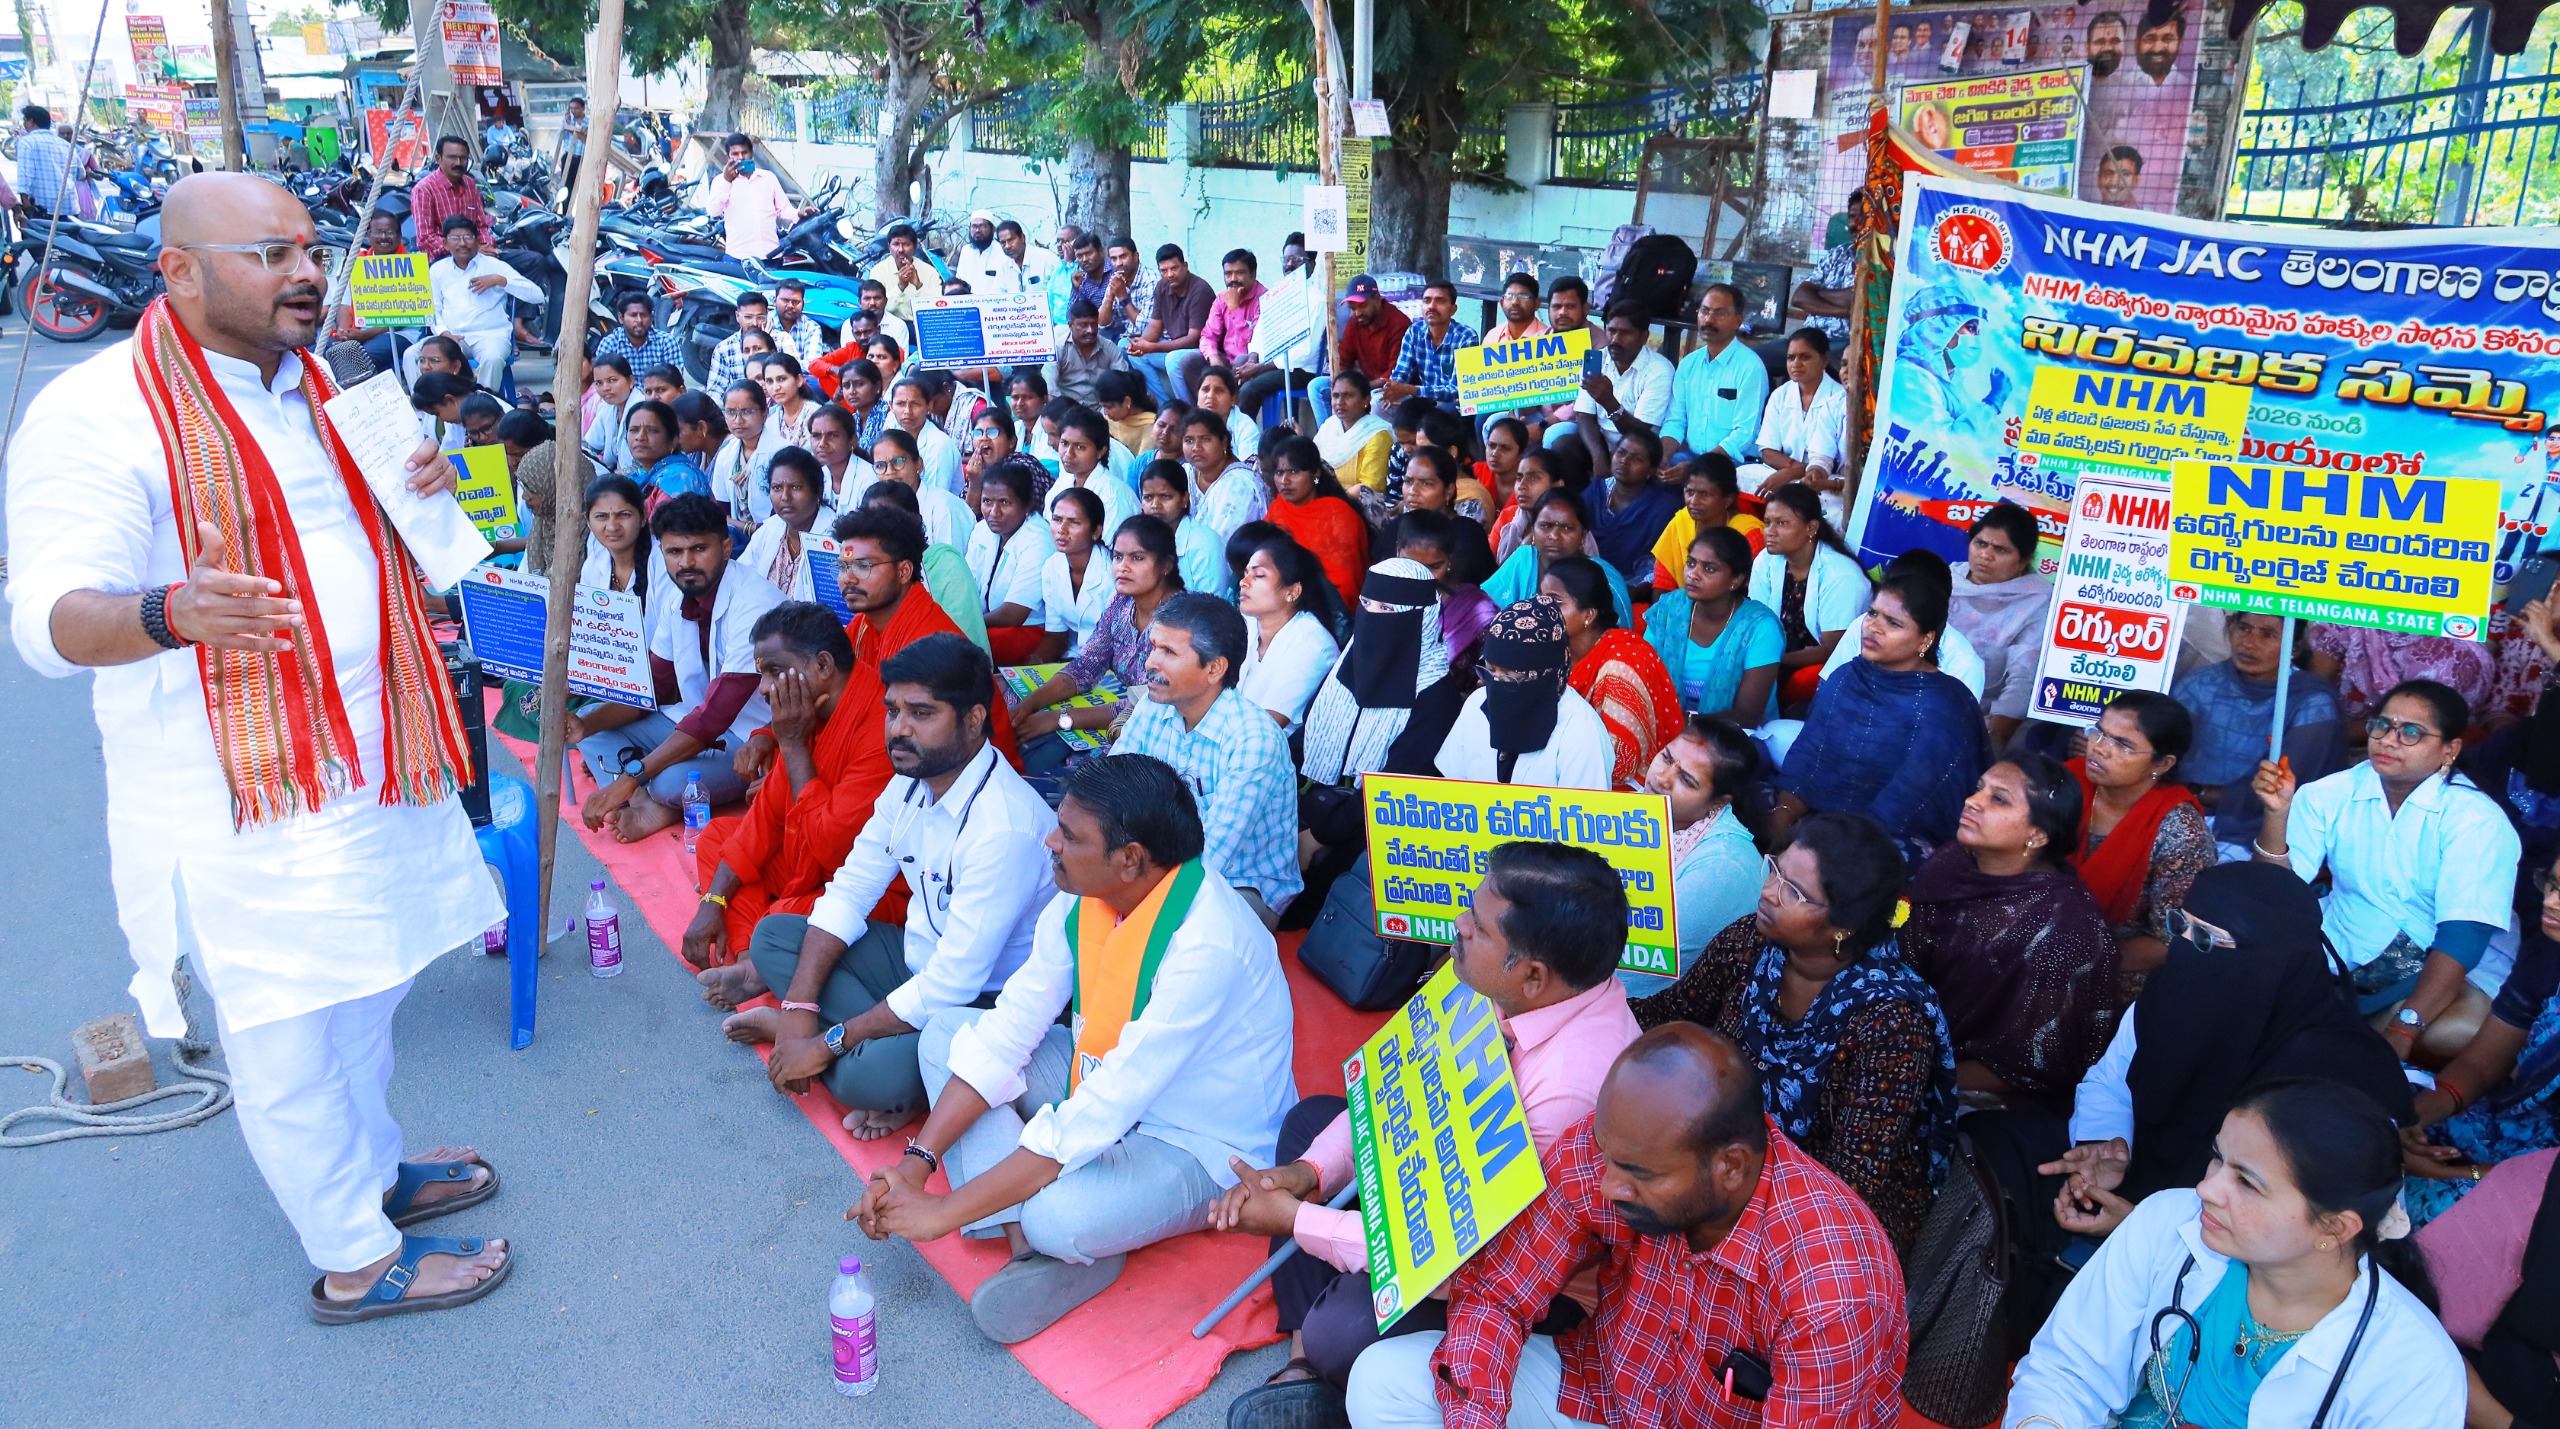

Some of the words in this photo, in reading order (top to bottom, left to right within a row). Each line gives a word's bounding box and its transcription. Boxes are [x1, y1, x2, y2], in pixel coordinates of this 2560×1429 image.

[456, 4, 490, 12] Nalanda
[462, 43, 498, 51] PHYSICS
[1953, 206, 1998, 223] HEALTH
[1992, 223, 2012, 273] MISSION
[363, 257, 415, 280] NHM
[2043, 223, 2150, 271] NHM
[2158, 232, 2268, 282] JAC
[2280, 249, 2483, 300] తెలంగాణ
[411, 316, 425, 324] STATE
[2023, 276, 2081, 302] NHM
[2085, 285, 2170, 319] ఉద్యోగుల
[2174, 304, 2297, 337] న్యాయమైన
[2302, 315, 2393, 347] హక్కుల
[2396, 321, 2477, 351] సాధన
[1483, 336, 1568, 367] NHM
[1506, 365, 1538, 379] ప్రజలకు
[1540, 361, 1554, 371] సేవ
[1463, 389, 1479, 400] మా
[1481, 382, 1527, 397] హక్కులకు
[1529, 376, 1567, 392] గుర్తింపు
[1477, 403, 1496, 412] NHM
[1498, 401, 1510, 409] JAC
[1512, 395, 1555, 407] TELANGANA
[1557, 392, 1578, 402] STATE
[2073, 374, 2207, 418] NHM
[2336, 357, 2546, 433] సమ్మె
[2032, 405, 2054, 424] ఏళ్ల
[2055, 409, 2099, 426] తరబడి
[2100, 415, 2151, 433] ప్రజలకు
[2153, 420, 2176, 436] సేవ
[2305, 413, 2363, 435] నుండి
[2025, 429, 2050, 445] మా
[2053, 432, 2126, 456] హక్కులకు
[2041, 454, 2070, 470] NHM
[2071, 461, 2092, 474] JAC
[2094, 465, 2162, 482] TELANGANA
[2208, 466, 2447, 524] NHM
[2106, 494, 2170, 531] NHM
[2080, 534, 2127, 553] తెలంగాణ
[2172, 512, 2337, 548] ఉద్యోగులను
[2345, 533, 2490, 563] అందరిని
[2067, 553, 2112, 581] NHM
[2113, 564, 2132, 587] వైద్య
[2190, 548, 2329, 588] రెగ్యులరైజ్
[2336, 562, 2459, 599] చేయాలి
[2077, 584, 2163, 609] ఉద్యోగులందరిని
[2204, 589, 2242, 606] NHM
[2246, 594, 2275, 610] JAC
[2280, 598, 2380, 625] TELANGANA
[2386, 612, 2436, 632] STATE
[586, 621, 639, 638] ఉద్యోగుల
[2060, 606, 2168, 657] రెగ్యులర్
[2070, 653, 2137, 683] చేయాలి
[607, 689, 640, 705] (NHM-JAC)
[2062, 683, 2101, 704] NHM
[1374, 791, 1479, 834] మహిళా
[1485, 795, 1661, 849] ఉద్యోగులకు
[1386, 838, 1471, 874] వేతనంతో
[1384, 875, 1452, 906] ప్రసూతి
[1349, 1081, 1365, 1114] NHM
[1376, 1033, 1420, 1156] రెగ్యులరైజ్
[1442, 982, 1529, 1184] NHM
[1353, 1115, 1369, 1145] JAC
[1407, 993, 1450, 1130] ఉద్యోగులను
[1434, 1125, 1480, 1258] అందరిని
[1358, 1143, 1383, 1231] TELANGANA
[1397, 1150, 1435, 1269] చేయాలి
[1370, 1229, 1391, 1284] STATE
